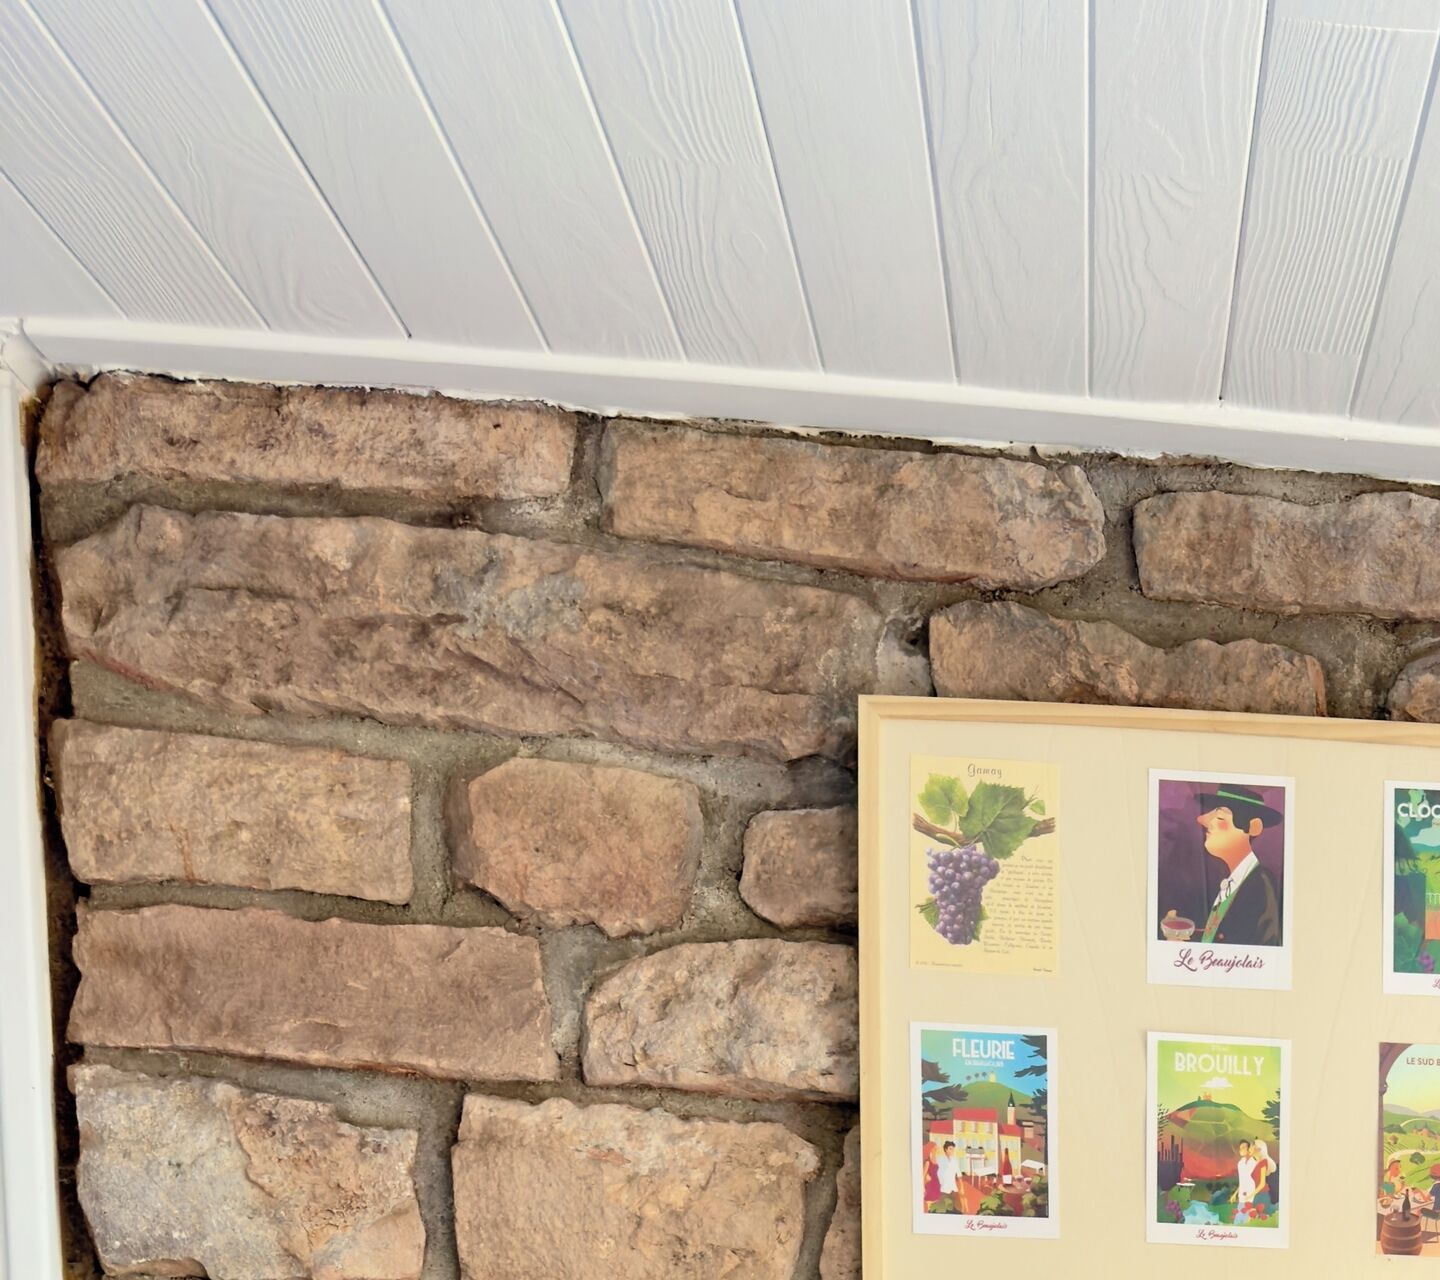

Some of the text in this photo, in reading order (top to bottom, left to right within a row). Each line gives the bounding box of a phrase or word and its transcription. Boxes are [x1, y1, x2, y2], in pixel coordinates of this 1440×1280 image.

[967, 763, 1003, 778] Gamay
[1174, 948, 1265, 973] Le Beaujolais
[952, 1038, 1015, 1060] FLEURIE
[1174, 1051, 1265, 1076] BROUILLY
[1406, 1057, 1416, 1065] LE
[1417, 1058, 1435, 1066] SUD
